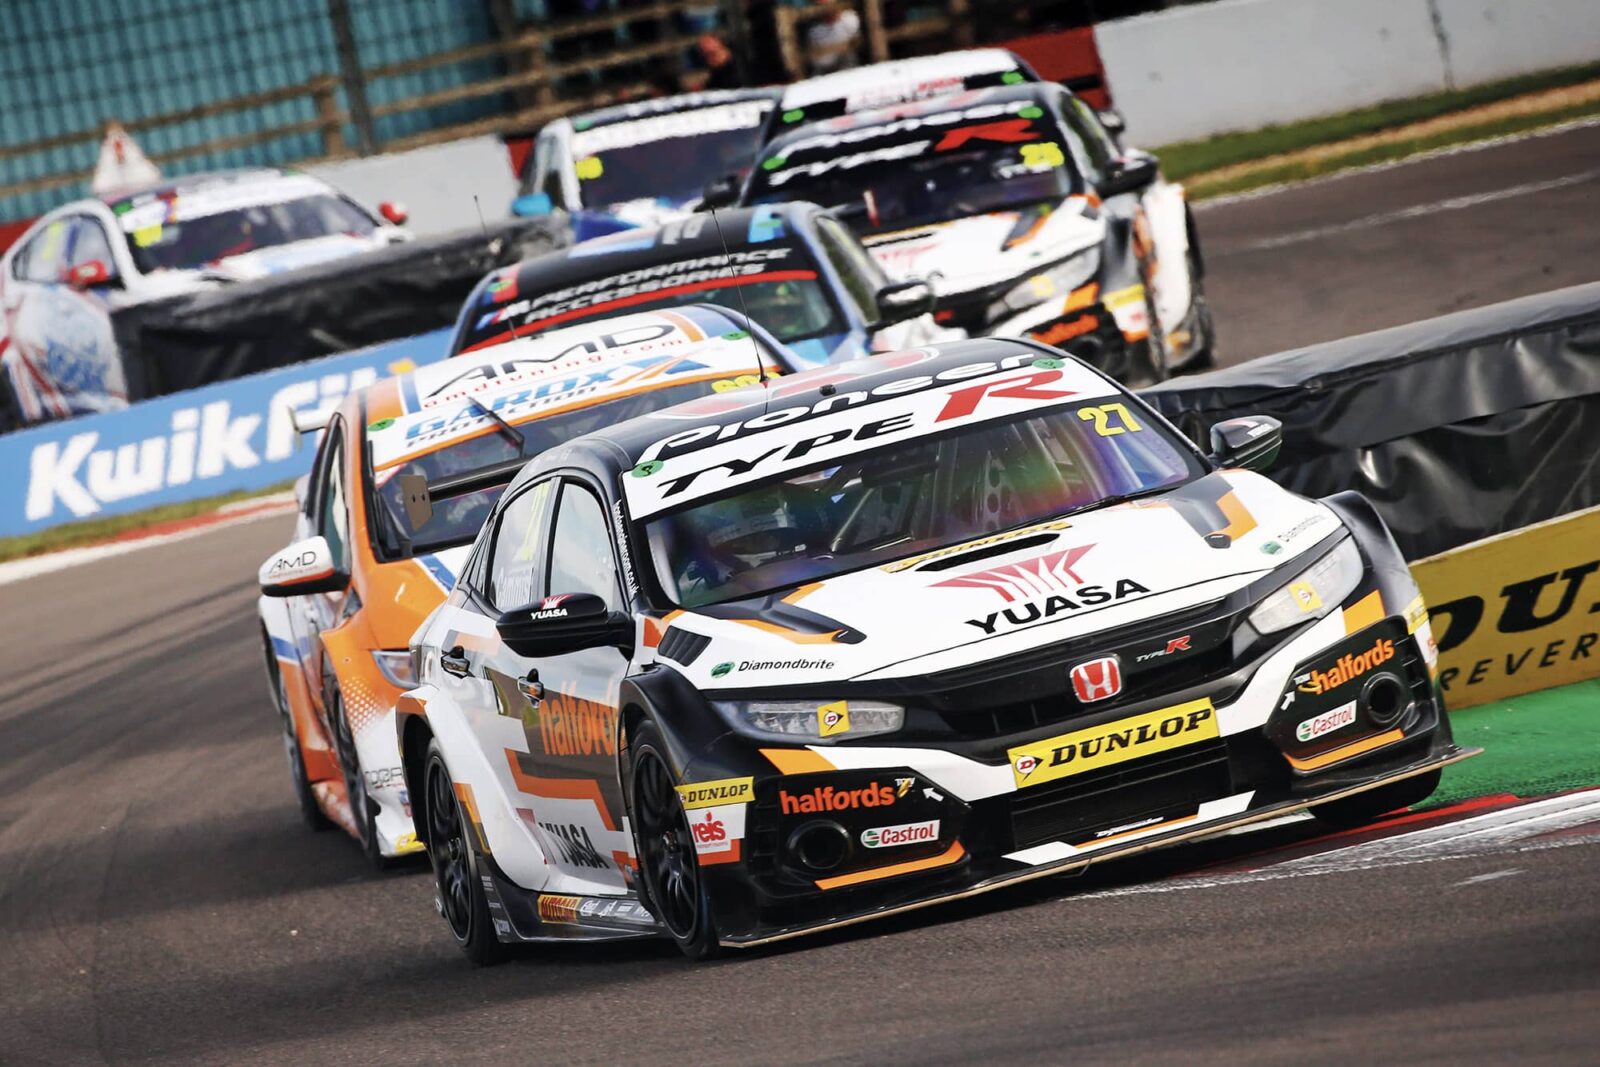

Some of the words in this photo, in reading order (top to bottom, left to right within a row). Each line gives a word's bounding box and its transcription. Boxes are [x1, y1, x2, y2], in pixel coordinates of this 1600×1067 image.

[524, 262, 768, 325] ACCESSORIES
[531, 247, 793, 309] PERFORMANCE
[426, 323, 677, 400] AMD
[406, 384, 599, 448] PROTCTION
[634, 353, 1035, 467] pioneer
[657, 411, 915, 499] TYPE
[934, 370, 1082, 423] R
[1076, 402, 1143, 437] 27
[25, 400, 261, 521] Kwik
[268, 551, 317, 574] AMD
[530, 608, 569, 621] YUASA
[964, 578, 1152, 635] YUASA
[1426, 559, 1600, 654] DU
[738, 658, 836, 673] Diamondbrite
[1135, 650, 1168, 663] TYPE
[1164, 634, 1194, 655] R
[1311, 638, 1397, 696] halfords
[540, 664, 618, 758] halford
[1048, 708, 1212, 768] DUNLOP
[1313, 703, 1354, 735] Castrol
[687, 783, 750, 803] DUNLOP
[778, 781, 896, 815] halfords
[691, 811, 727, 844] reis
[880, 823, 936, 846] Castrol
